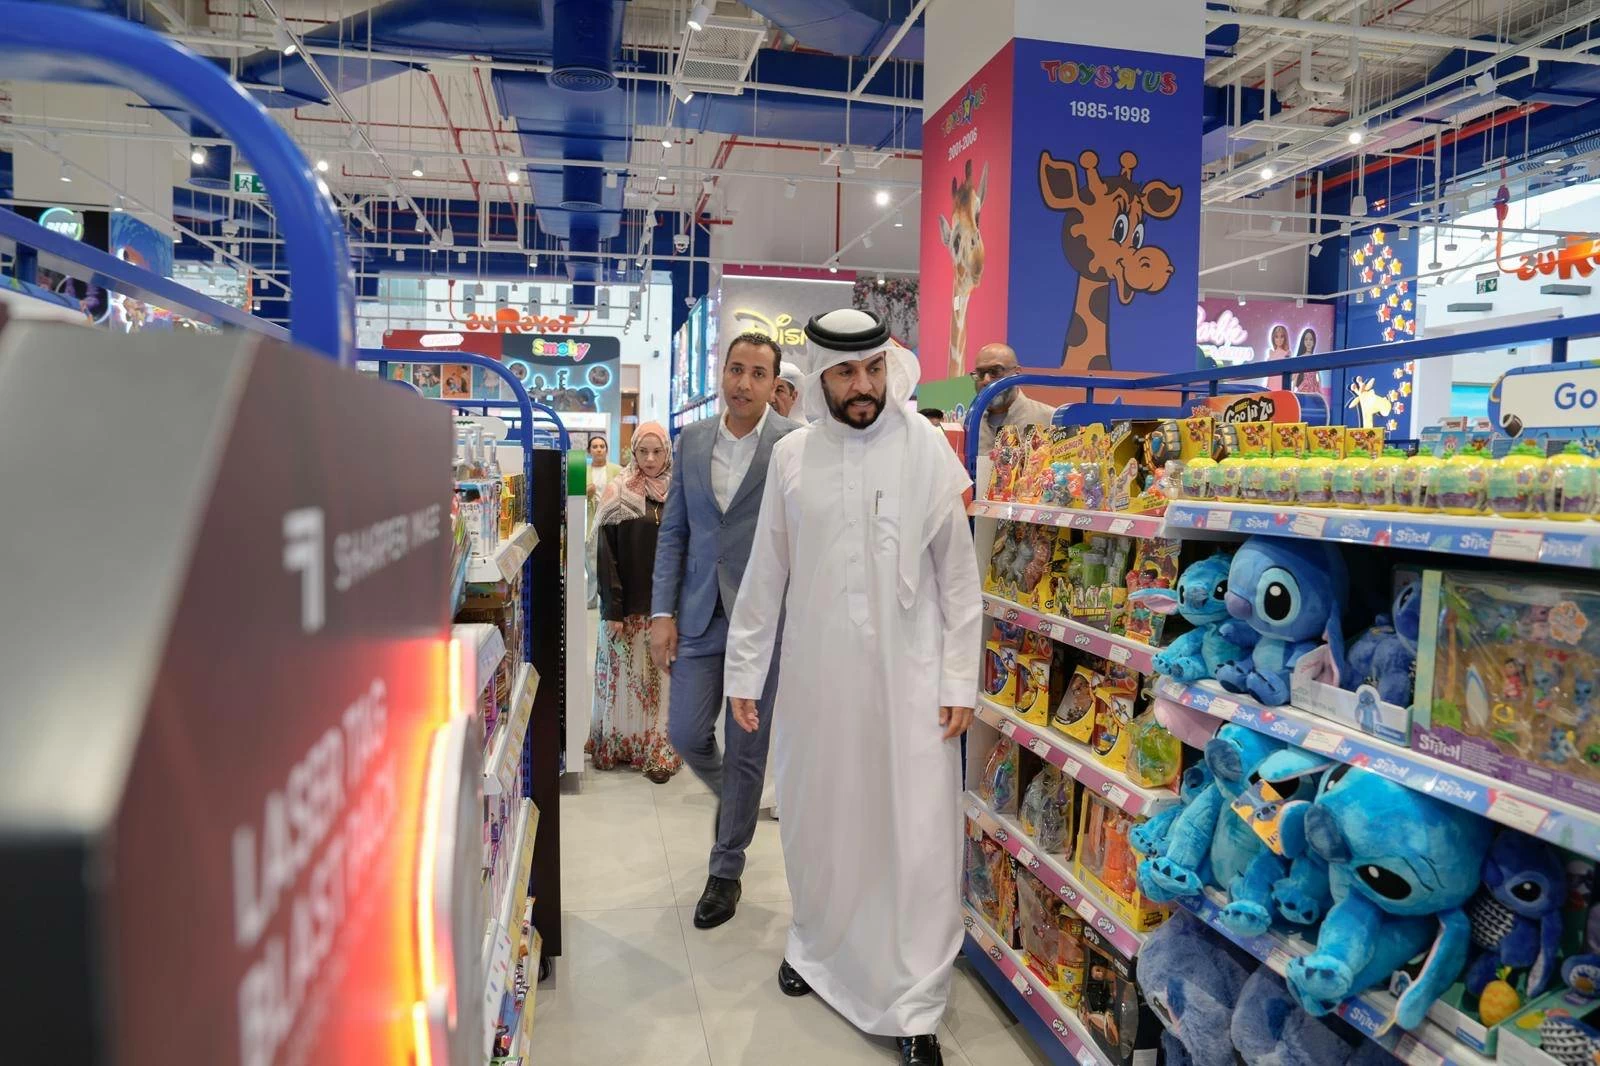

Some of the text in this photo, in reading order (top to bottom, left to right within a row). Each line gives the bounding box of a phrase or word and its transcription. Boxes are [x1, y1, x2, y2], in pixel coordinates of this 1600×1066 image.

[1142, 70, 1179, 96] US
[1069, 100, 1151, 124] 1985-1998
[532, 338, 591, 362] Smoby
